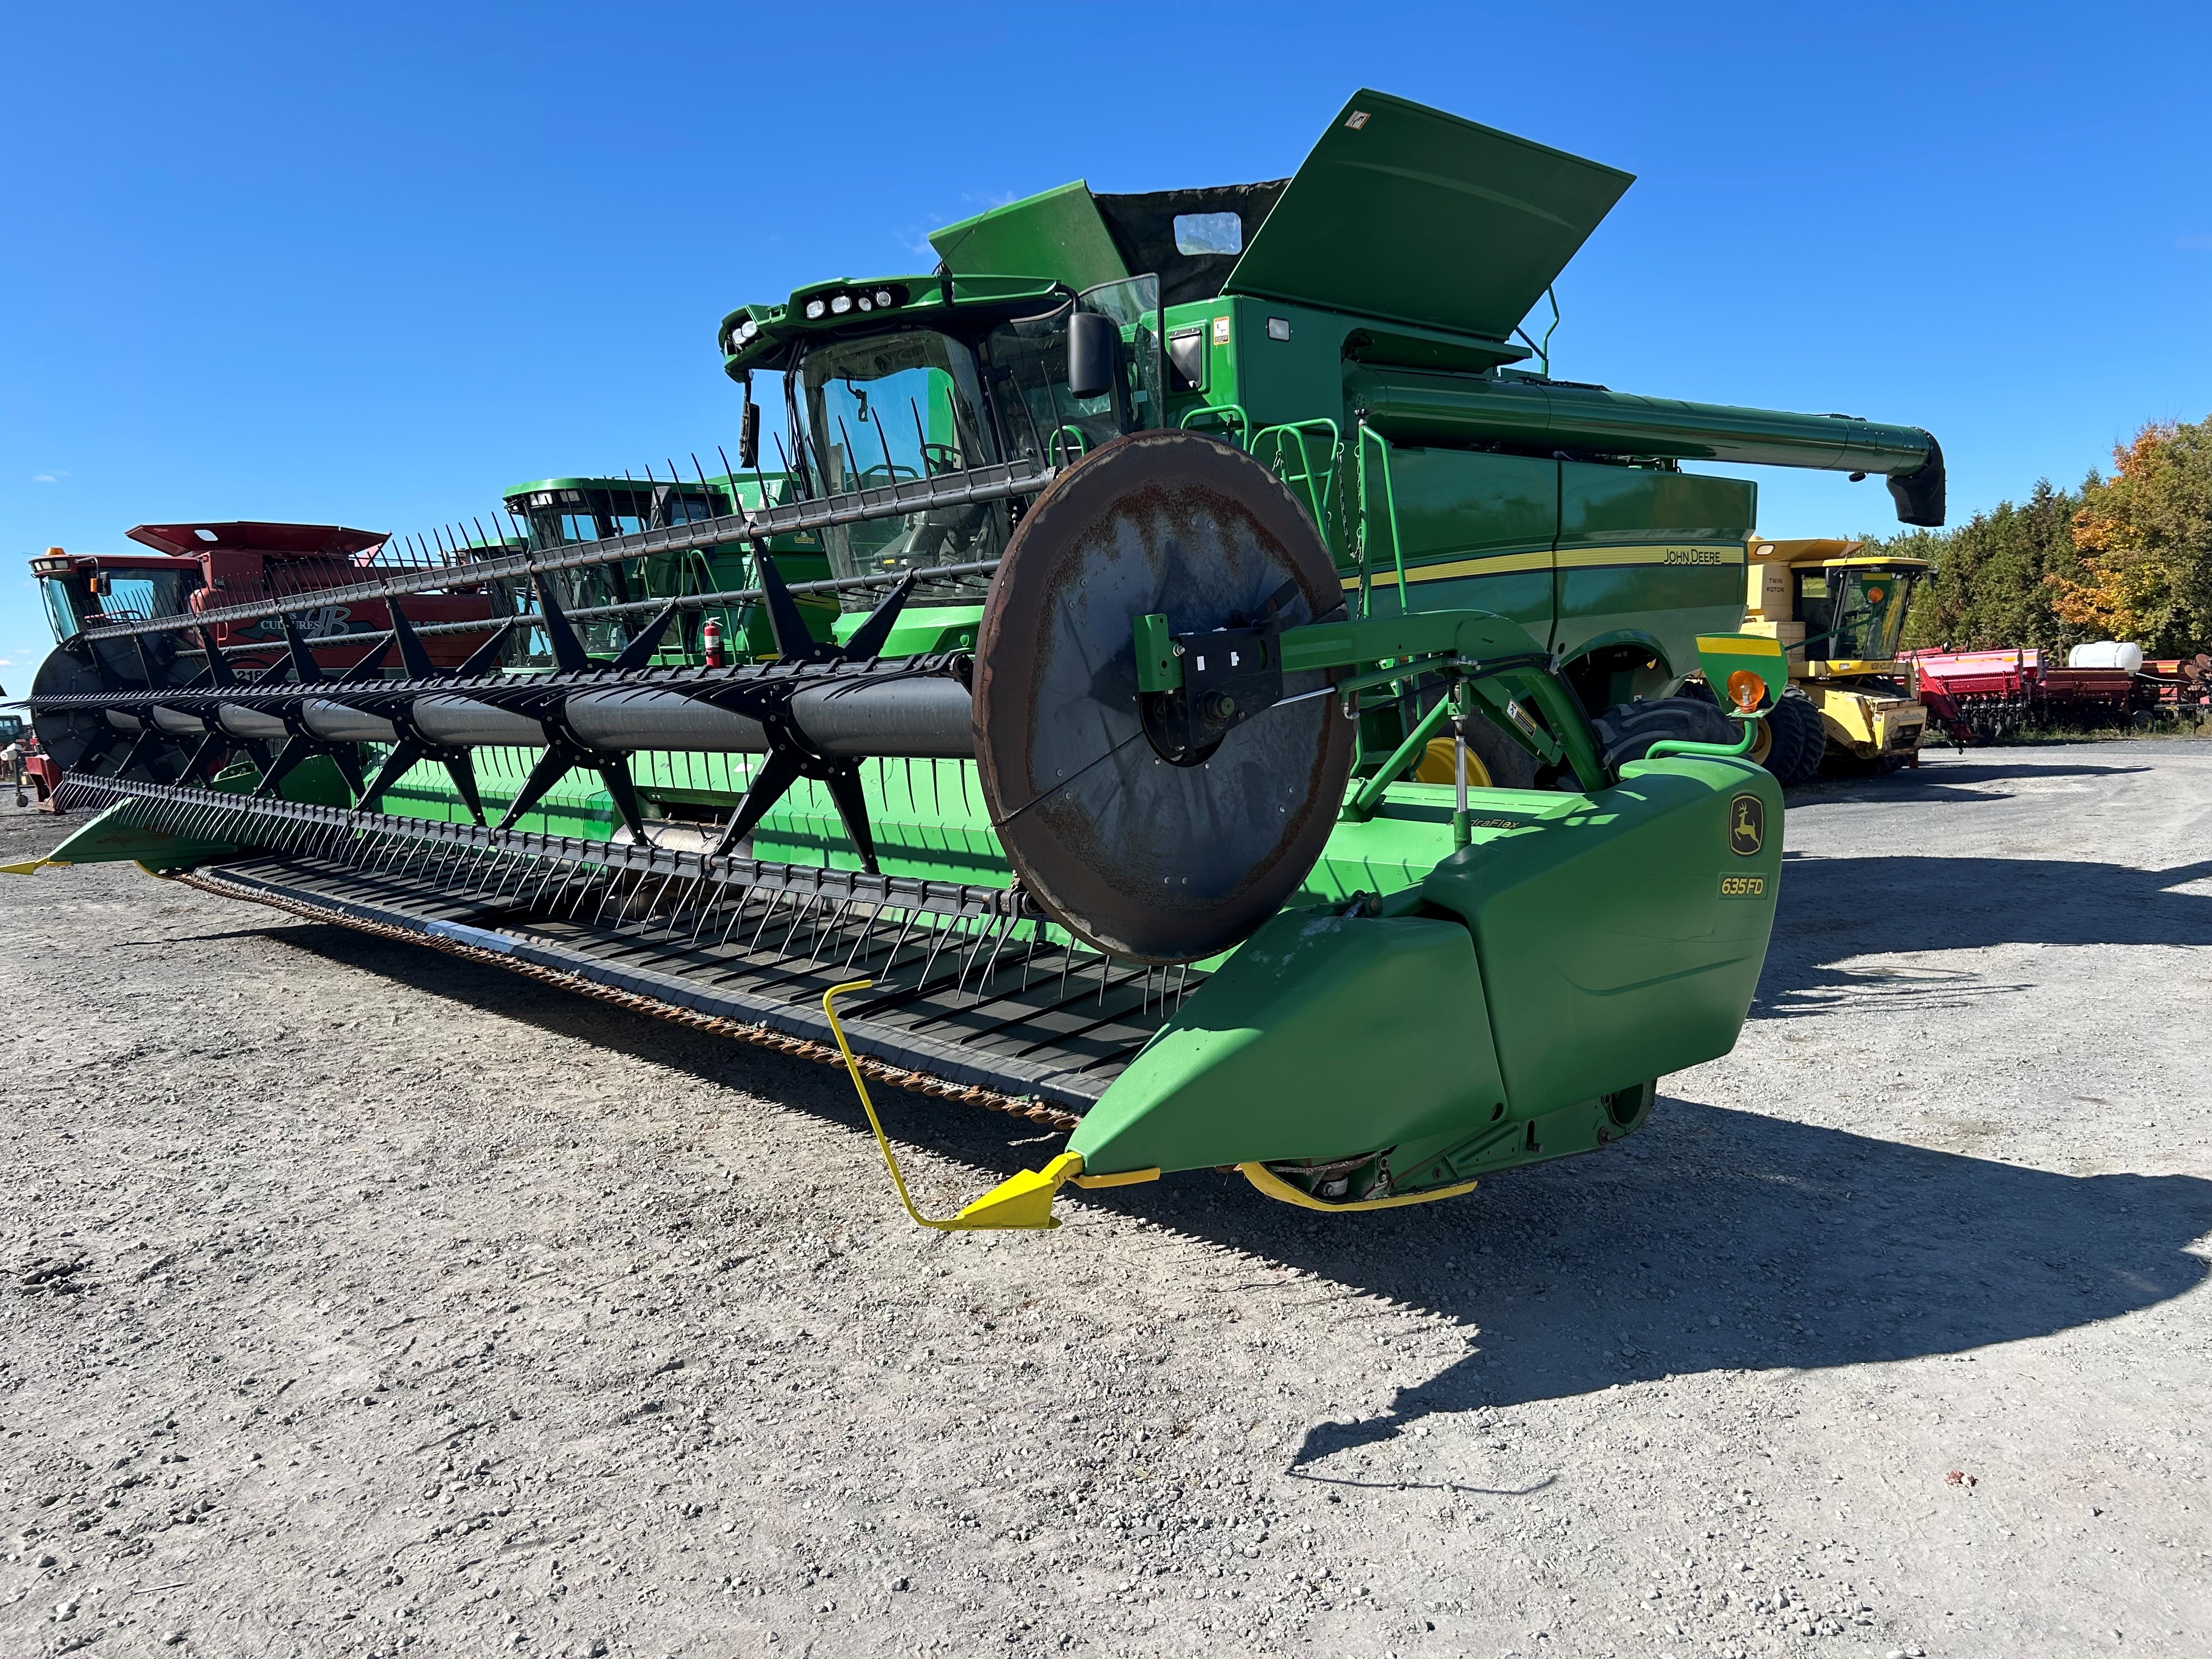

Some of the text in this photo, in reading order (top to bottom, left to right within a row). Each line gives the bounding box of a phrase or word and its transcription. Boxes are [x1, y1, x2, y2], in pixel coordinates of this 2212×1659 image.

[1664, 549, 1721, 562] JOHN DEERE
[261, 620, 320, 630] CULURES
[237, 670, 266, 681] 218
[1448, 817, 1520, 828] draFlex
[1722, 878, 1763, 894] 635FD
